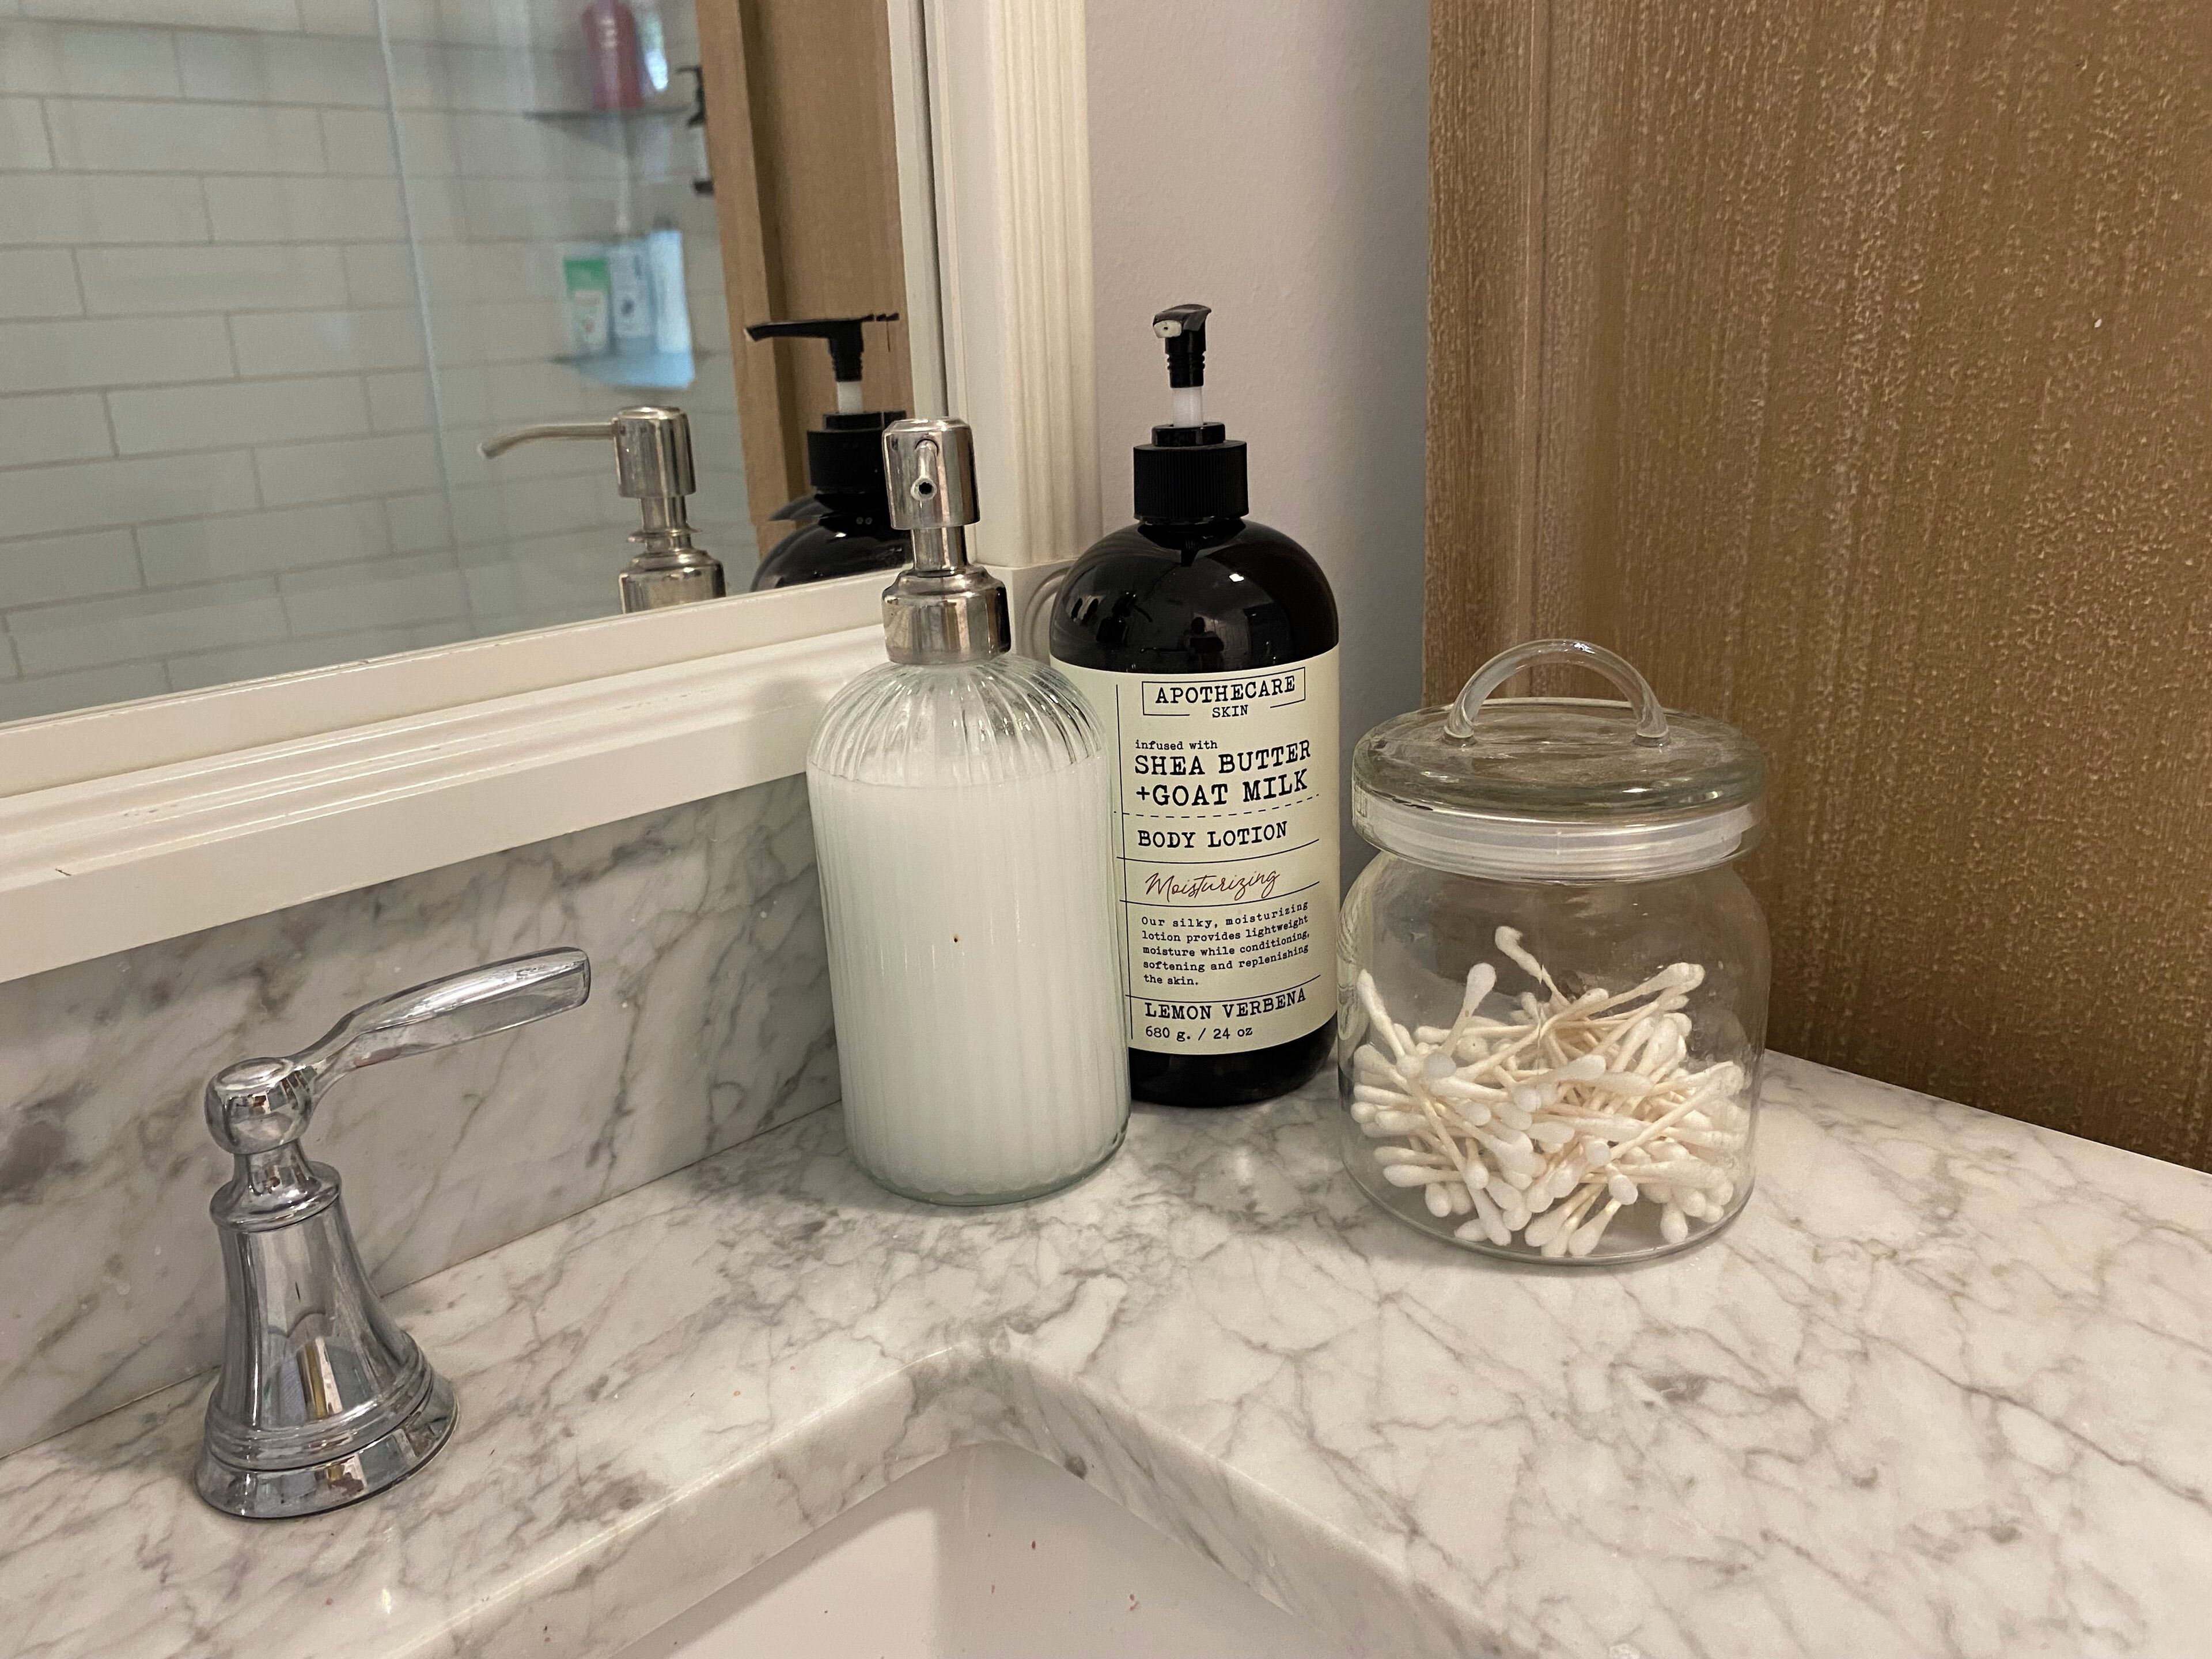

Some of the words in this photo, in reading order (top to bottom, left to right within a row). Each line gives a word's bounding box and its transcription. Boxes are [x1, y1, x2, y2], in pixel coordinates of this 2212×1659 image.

[1155, 675, 1295, 704] APOTHECARE
[1211, 704, 1249, 718] SKIN
[1134, 755, 1206, 776] SHEA
[1218, 739, 1311, 774] BUTTER
[1135, 739, 1184, 751] infused
[1188, 740, 1218, 750] with
[1135, 783, 1228, 807] +GOAT
[1242, 768, 1308, 804] MILK
[1137, 830, 1196, 849] BODY
[1206, 820, 1287, 848] LOTION
[1145, 870, 1281, 902] Moisturizing
[1141, 916, 1165, 926] Our
[1172, 918, 1218, 929] silky,
[1225, 902, 1308, 926] moisturizing
[1142, 930, 1181, 942] lotion
[1186, 931, 1241, 944] provides
[1245, 915, 1309, 938] lightweight
[1142, 945, 1195, 957] moisture
[1200, 946, 1235, 956] while
[1239, 930, 1310, 953] conditioning,
[1143, 961, 1205, 973] softening
[1210, 960, 1233, 971] and
[1238, 942, 1309, 969] replenishing
[1143, 974, 1163, 984] the
[1167, 976, 1199, 986] skin.
[1144, 1002, 1212, 1020] LEMON
[1221, 987, 1306, 1018] VERBENA
[1145, 1025, 1171, 1039] 680
[1176, 1031, 1191, 1042] g.
[1198, 1027, 1207, 1041] /
[1213, 1027, 1231, 1040] 24
[1237, 1027, 1253, 1037] oz
